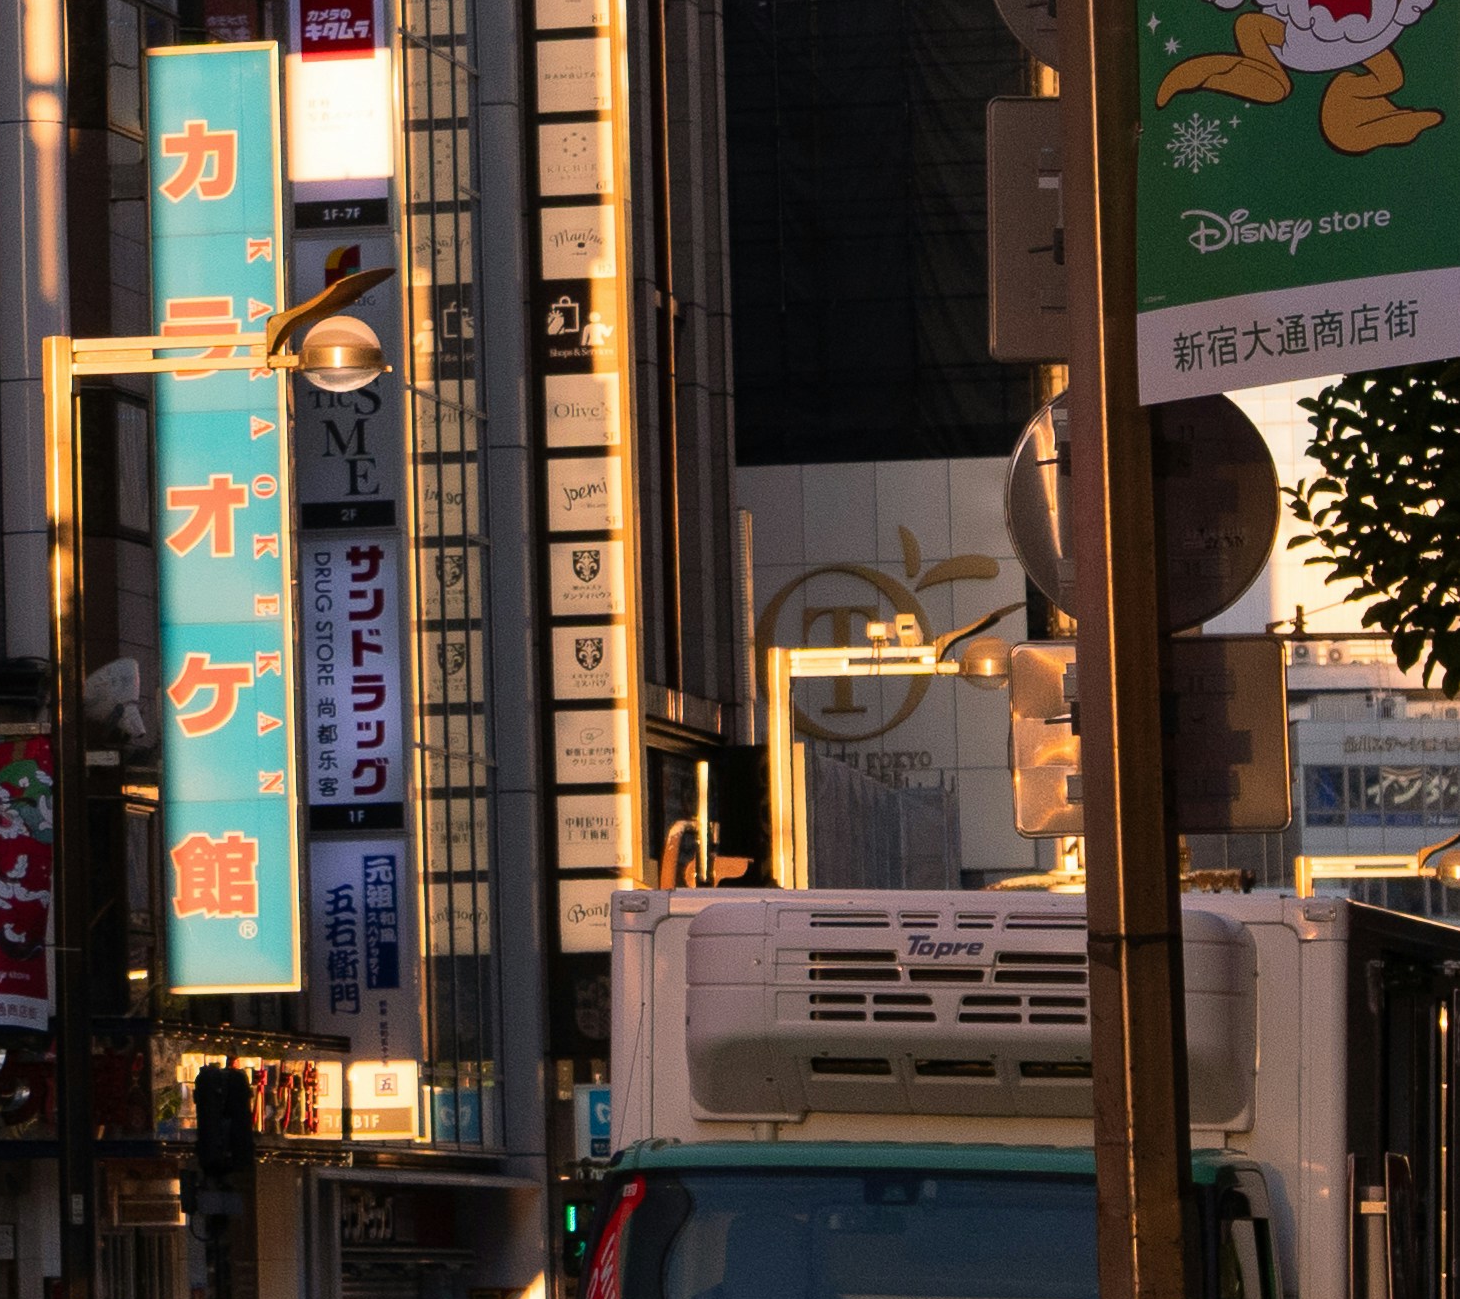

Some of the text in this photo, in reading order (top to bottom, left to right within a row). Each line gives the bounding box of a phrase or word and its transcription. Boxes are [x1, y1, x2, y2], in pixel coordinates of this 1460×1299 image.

[306, 8, 352, 24] カメラの
[304, 20, 373, 43] キタムラ
[322, 205, 362, 221] 1F-7F
[1318, 210, 1392, 235] store
[1172, 299, 1419, 373] 新宿大通商店街
[159, 118, 259, 921] カラオケ館
[340, 508, 359, 522] 2F
[312, 551, 334, 614] DRUG
[317, 619, 336, 686] STORE
[345, 544, 391, 798] サンドラッグ
[348, 808, 366, 824] 1F
[324, 883, 361, 1016] 五右衛門
[907, 935, 985, 961] Topre
